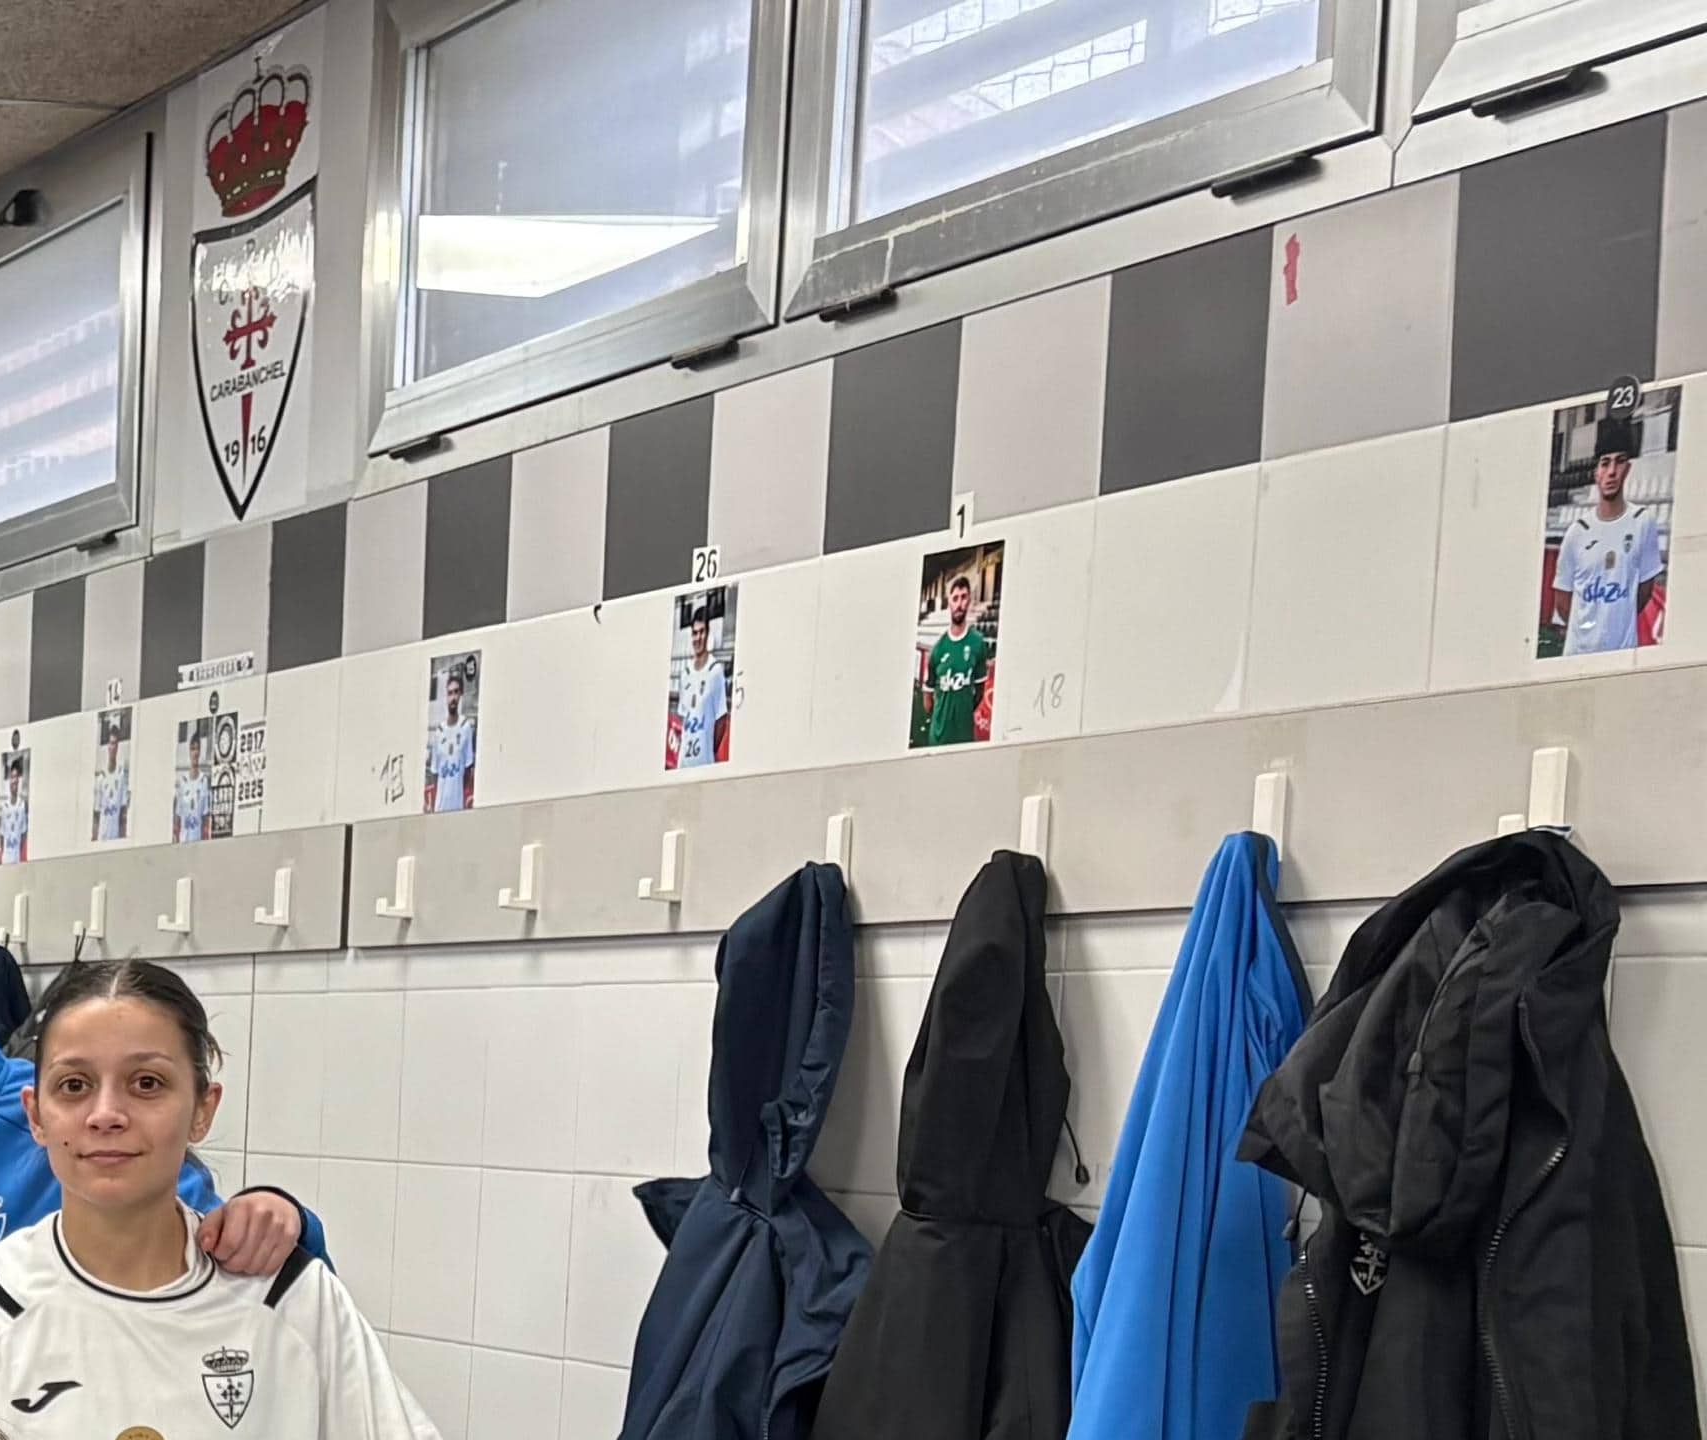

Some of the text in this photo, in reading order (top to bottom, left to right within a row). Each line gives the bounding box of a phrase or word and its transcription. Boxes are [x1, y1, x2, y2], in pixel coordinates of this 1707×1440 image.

[209, 360, 287, 402] CARABANCHEL
[1611, 385, 1636, 409] 23
[224, 425, 268, 467] 19 16
[956, 503, 966, 539] 1
[696, 549, 718, 583] 26
[1033, 672, 1066, 718] 18
